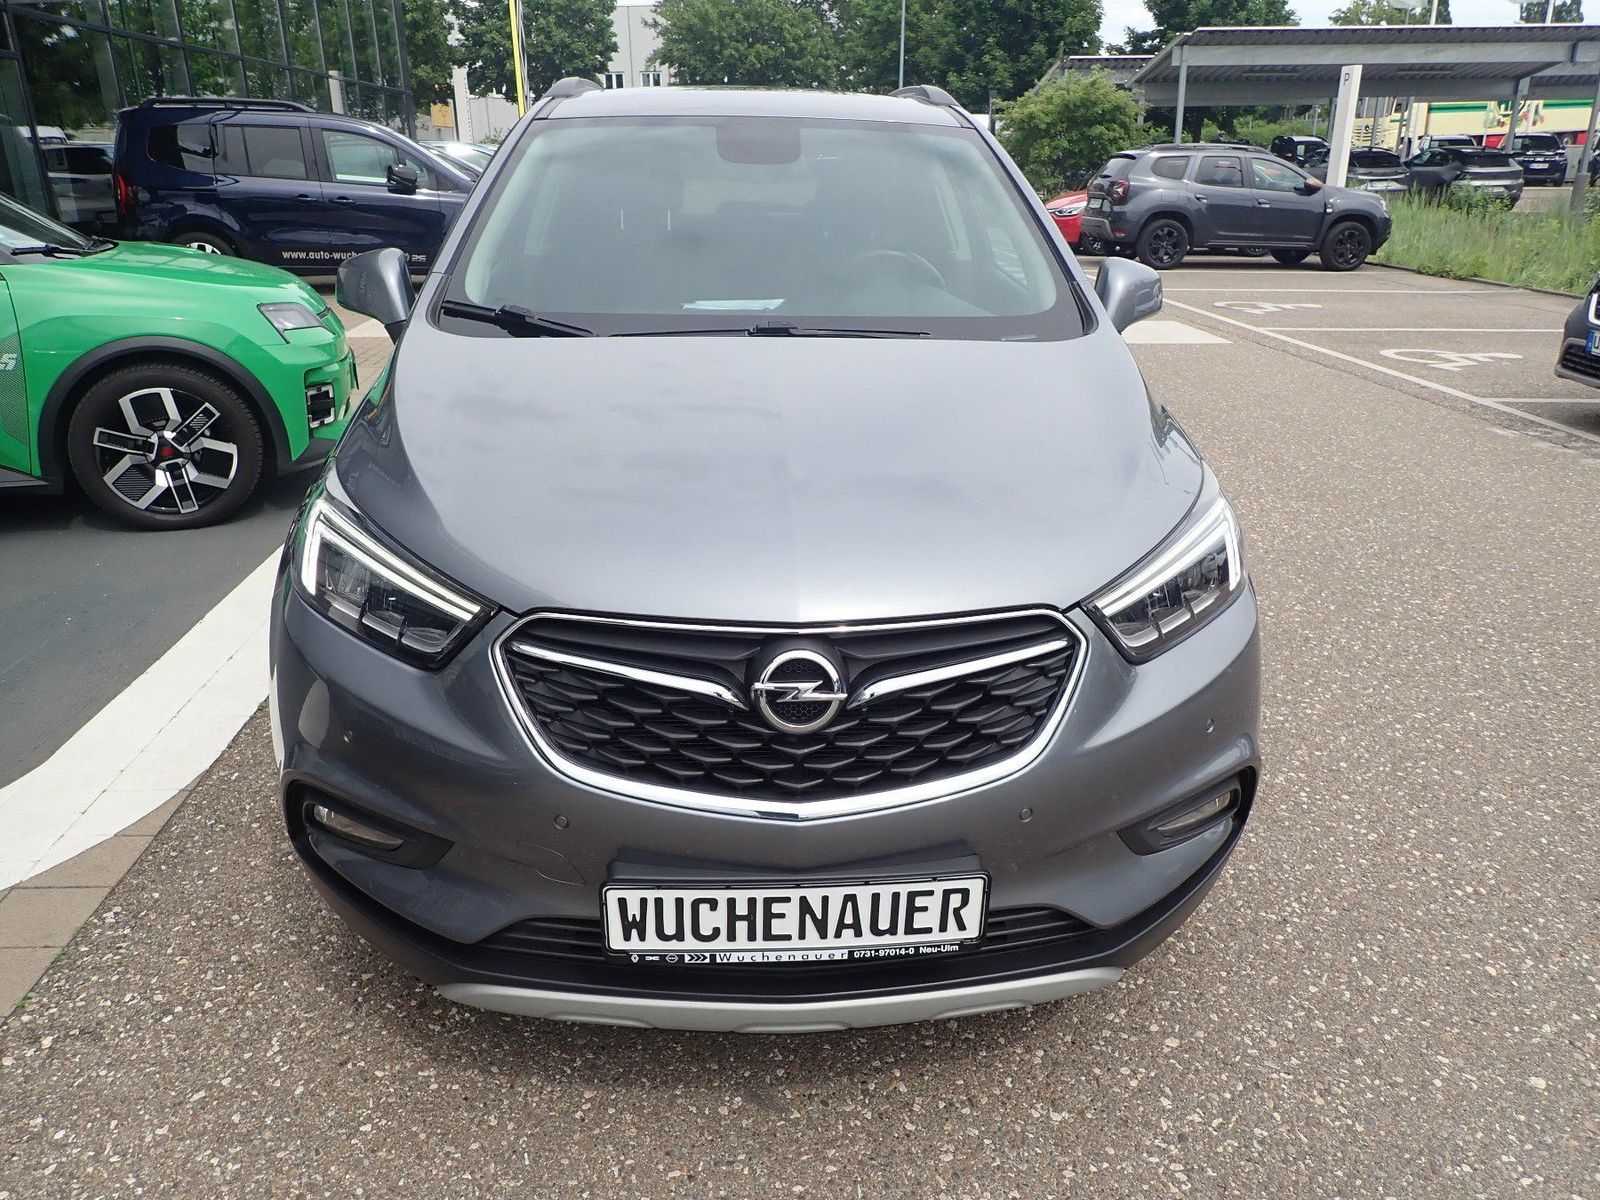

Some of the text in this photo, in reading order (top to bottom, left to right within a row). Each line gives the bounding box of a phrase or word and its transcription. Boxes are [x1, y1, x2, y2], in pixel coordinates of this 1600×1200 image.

[1343, 72, 1350, 86] P
[617, 888, 971, 942] WUCHENAUER
[718, 945, 959, 962] Wuchenauer 0731-97014-0 Neu-Ulm
